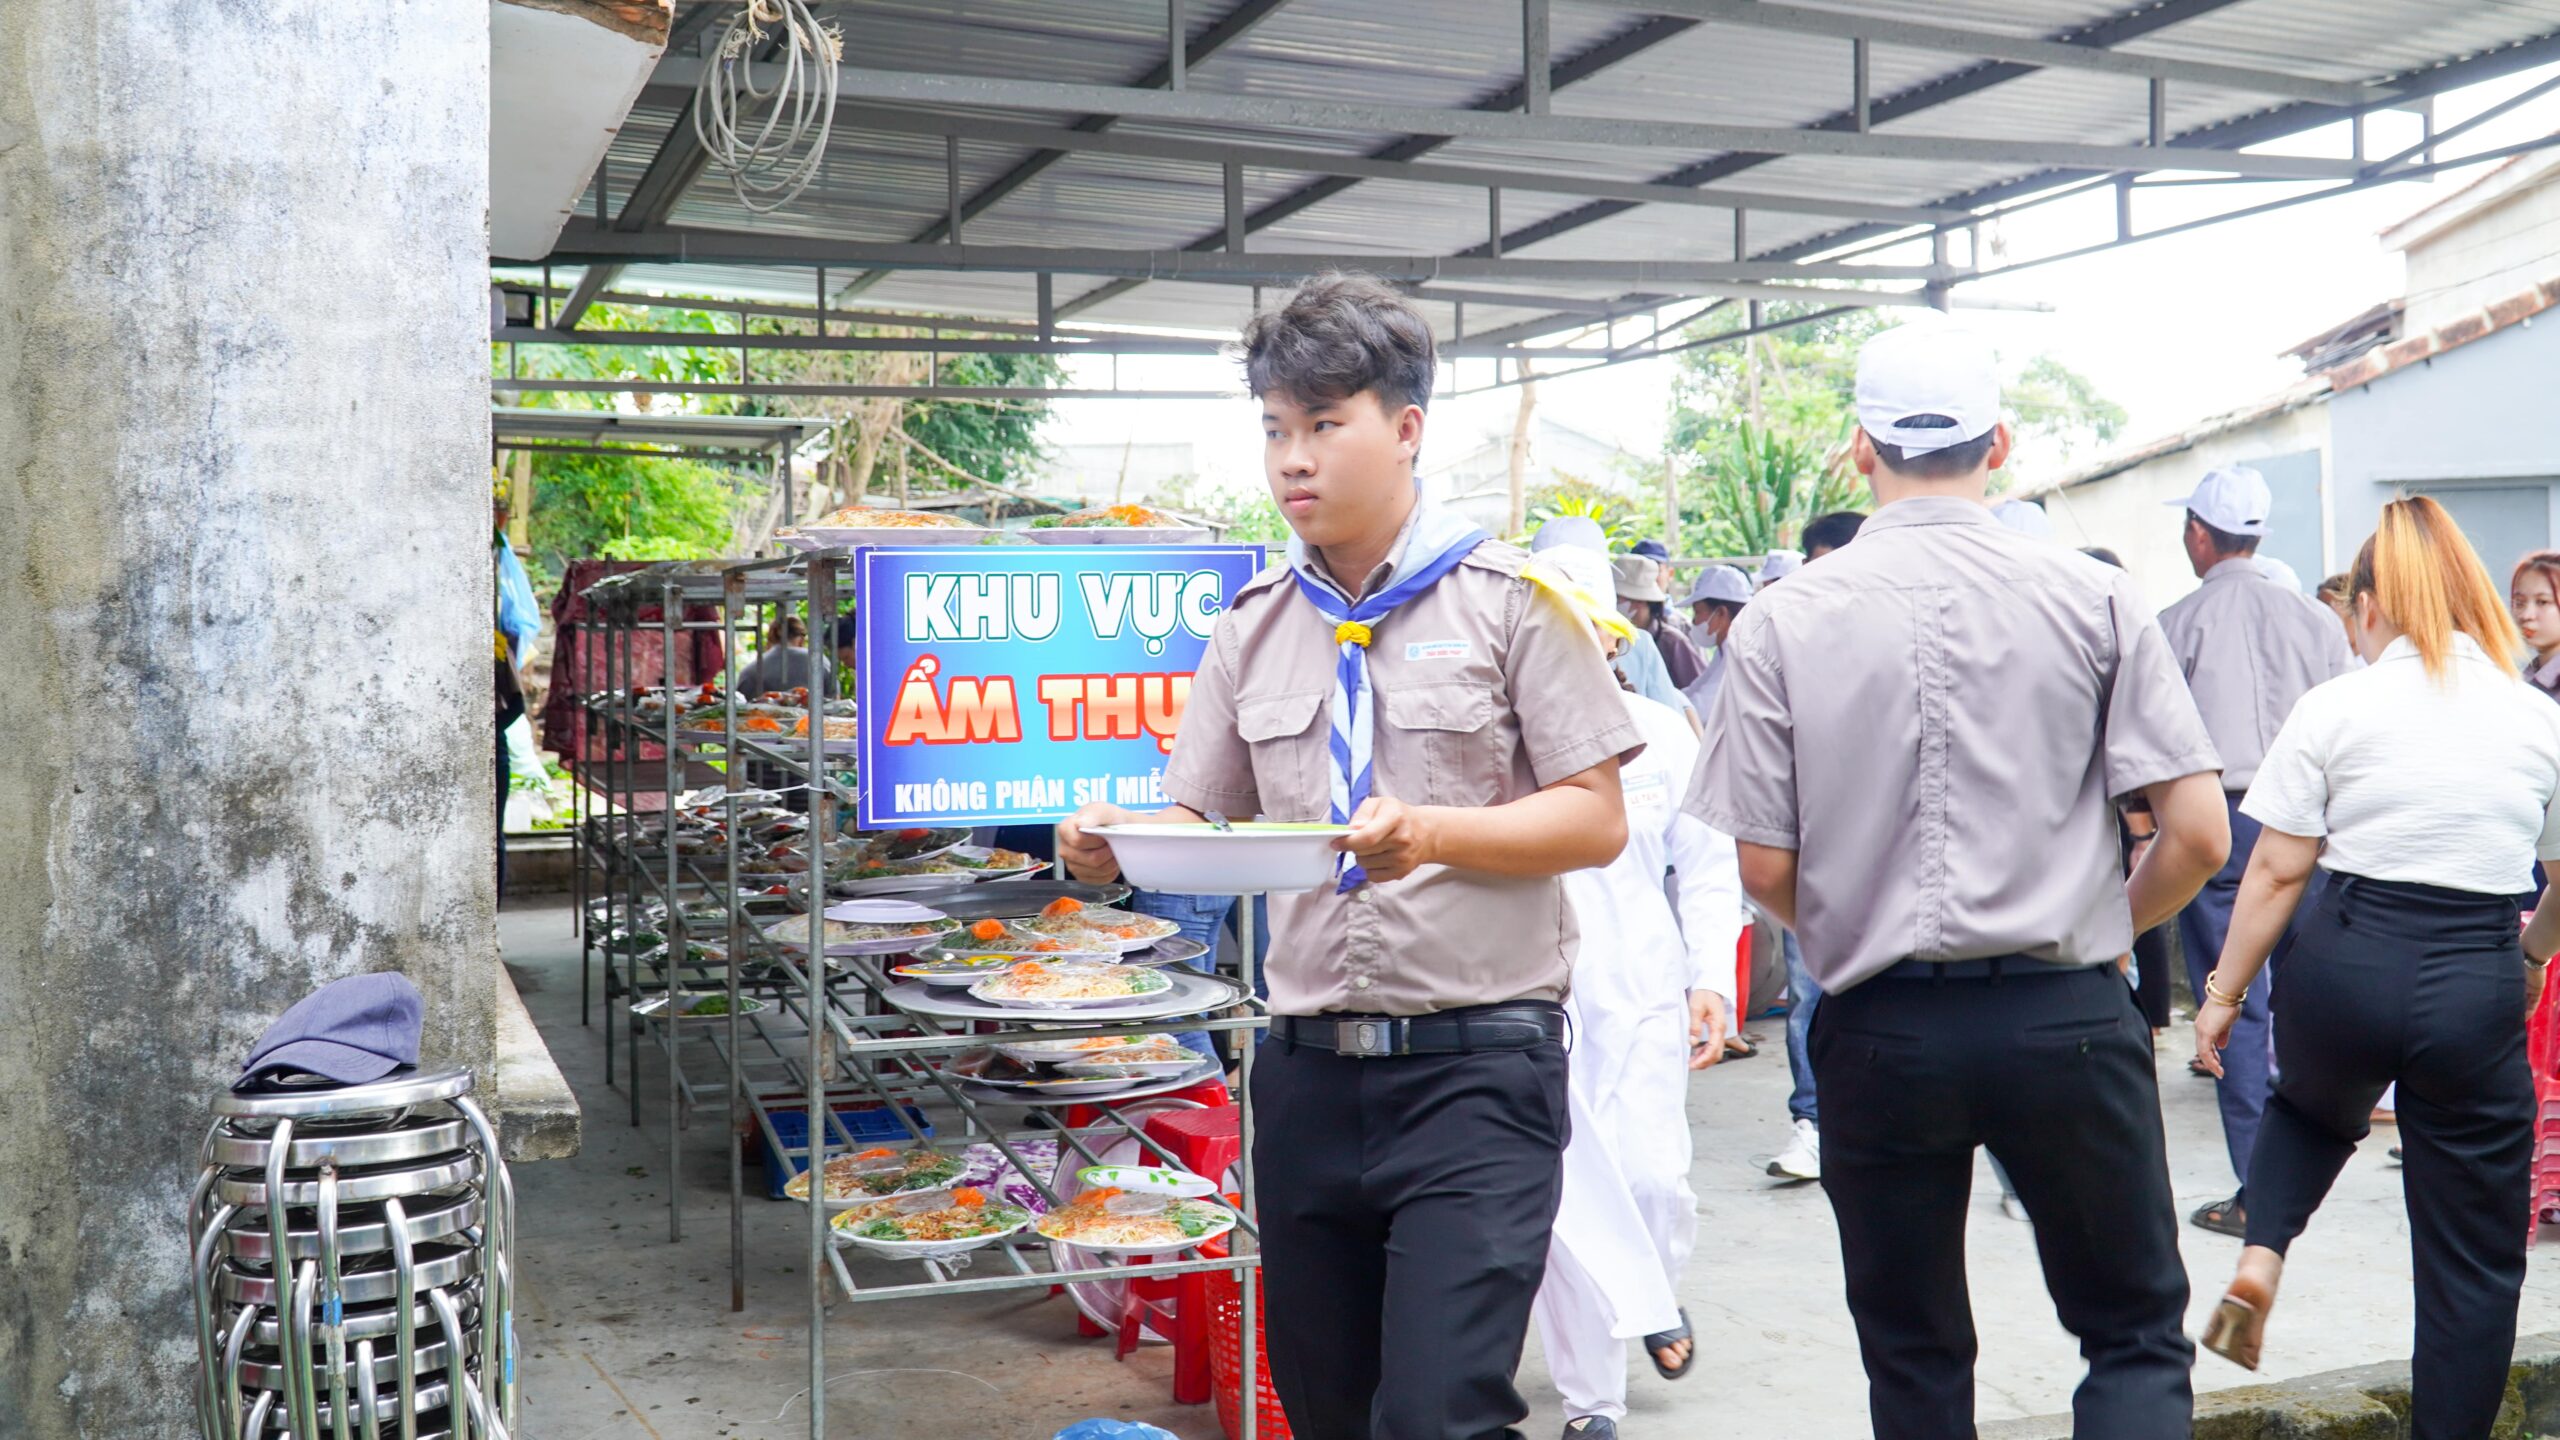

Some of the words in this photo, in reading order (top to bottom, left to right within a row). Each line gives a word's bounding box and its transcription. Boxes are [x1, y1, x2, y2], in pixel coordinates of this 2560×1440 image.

[905, 570, 1061, 643] KHU
[1076, 569, 1222, 657] VỰC
[884, 653, 1022, 746] ẨM
[895, 778, 987, 812] KHÔNG
[996, 775, 1064, 813] PHẬN
